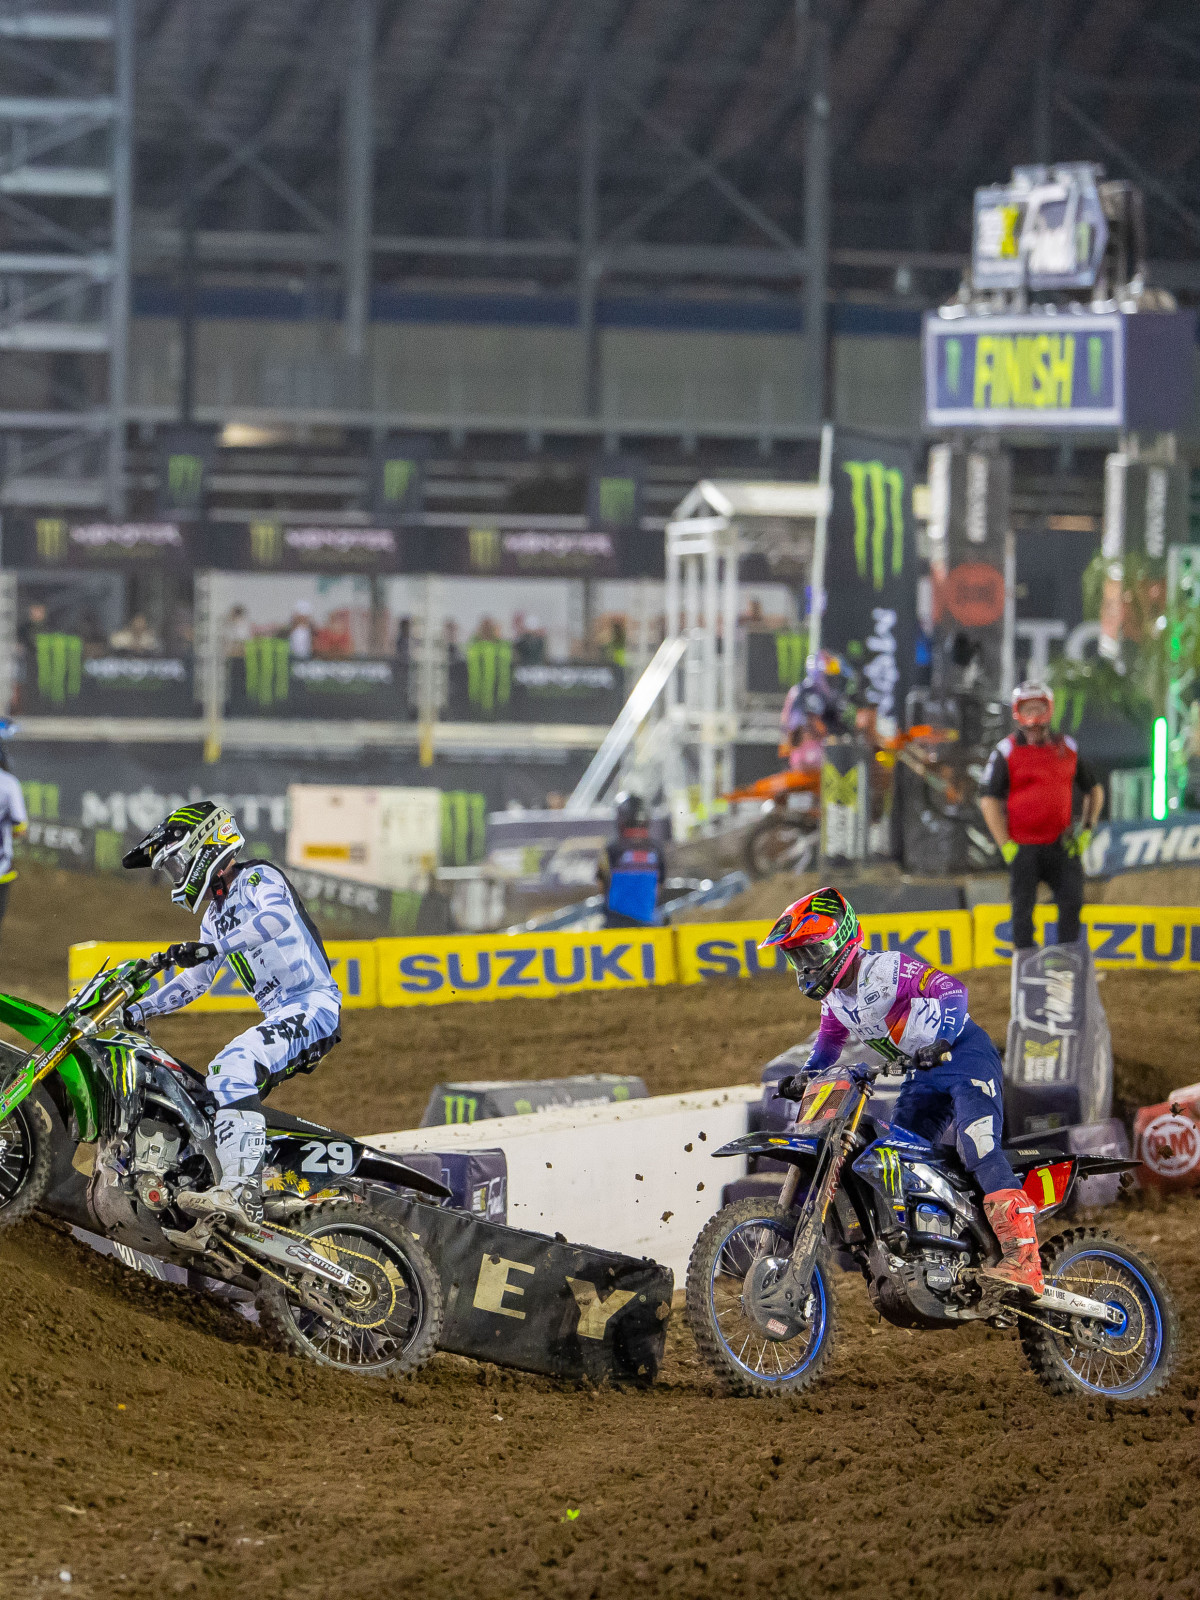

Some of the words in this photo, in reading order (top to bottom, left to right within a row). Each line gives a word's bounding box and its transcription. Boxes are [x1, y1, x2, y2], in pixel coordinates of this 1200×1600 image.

[973, 333, 1076, 410] FINISH
[399, 942, 656, 995] SUZUKI
[48, 1033, 72, 1060] CIRCUIT
[256, 1012, 310, 1046] FOX
[300, 1141, 353, 1174] 29
[1036, 1167, 1056, 1206] 1
